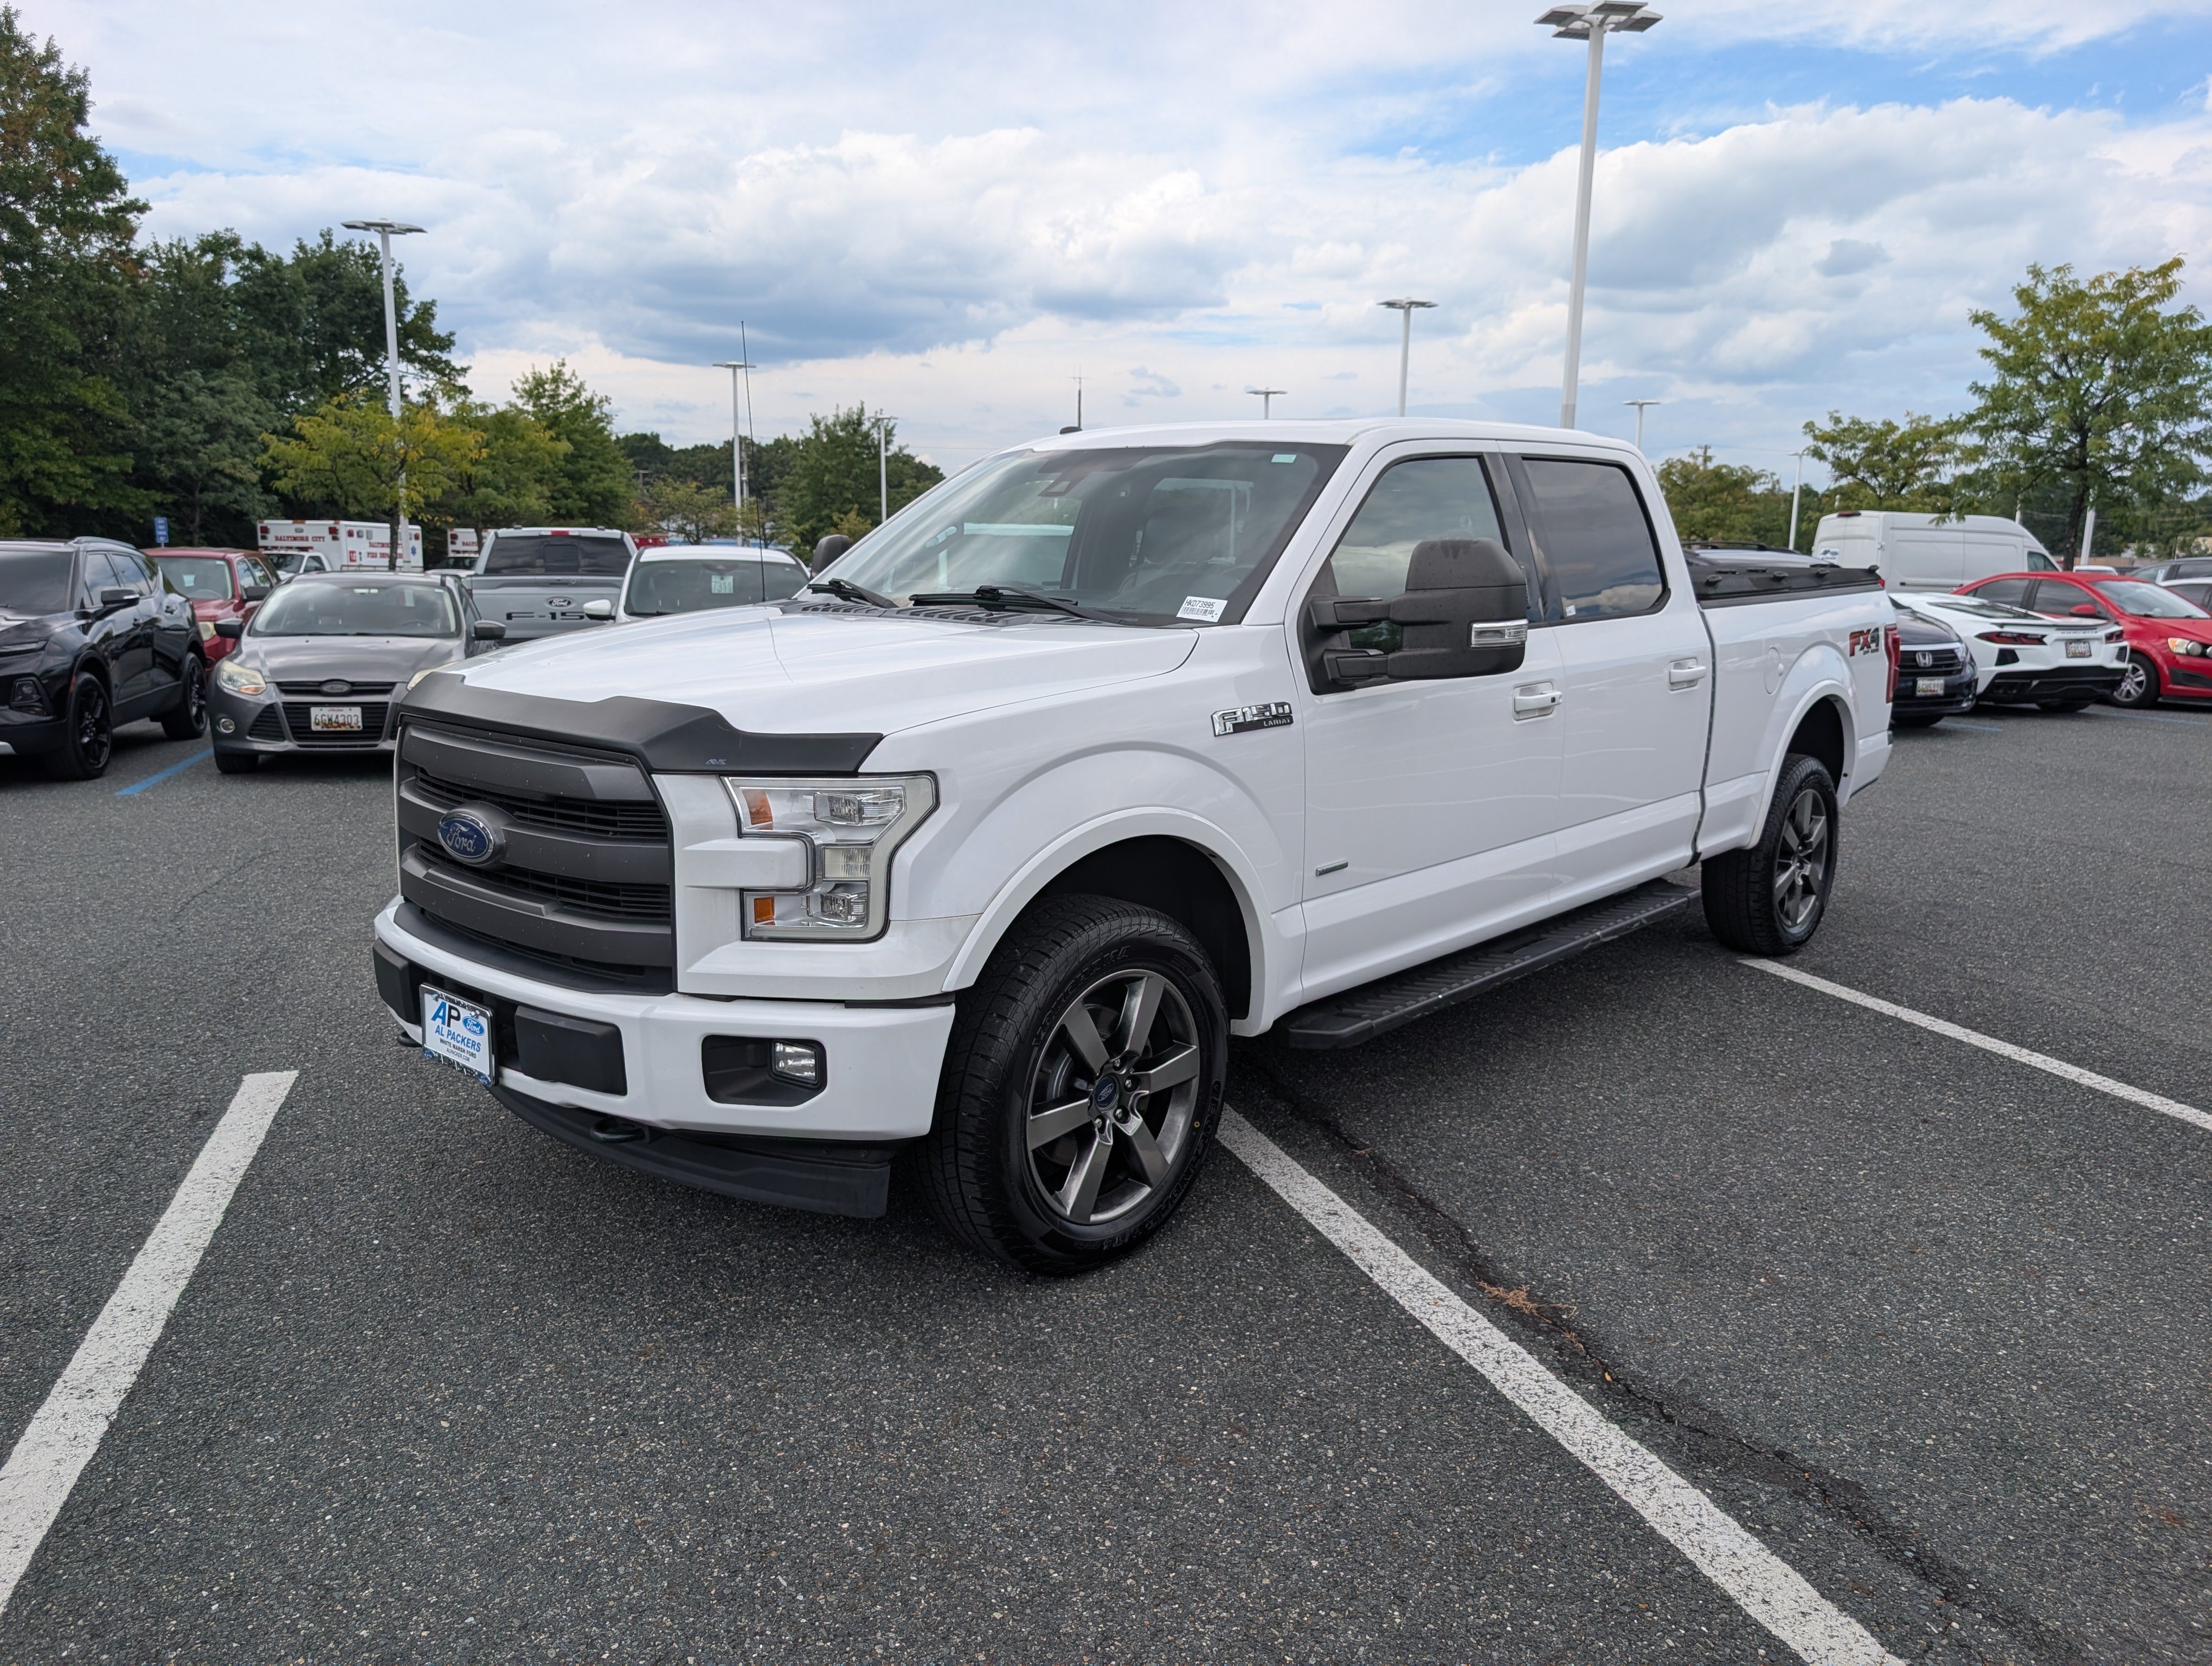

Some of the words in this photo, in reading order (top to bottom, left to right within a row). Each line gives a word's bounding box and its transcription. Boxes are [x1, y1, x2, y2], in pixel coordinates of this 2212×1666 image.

[1184, 599, 1216, 609] HKD73995
[506, 611, 585, 620] F-15
[1849, 627, 1880, 657] FX4
[1263, 717, 1291, 727] LARIAT
[446, 822, 477, 853] Ford
[431, 1001, 461, 1028] AP
[435, 1025, 445, 1036] AL
[446, 1029, 481, 1053] PACKERS
[466, 1049, 477, 1059] FORD
